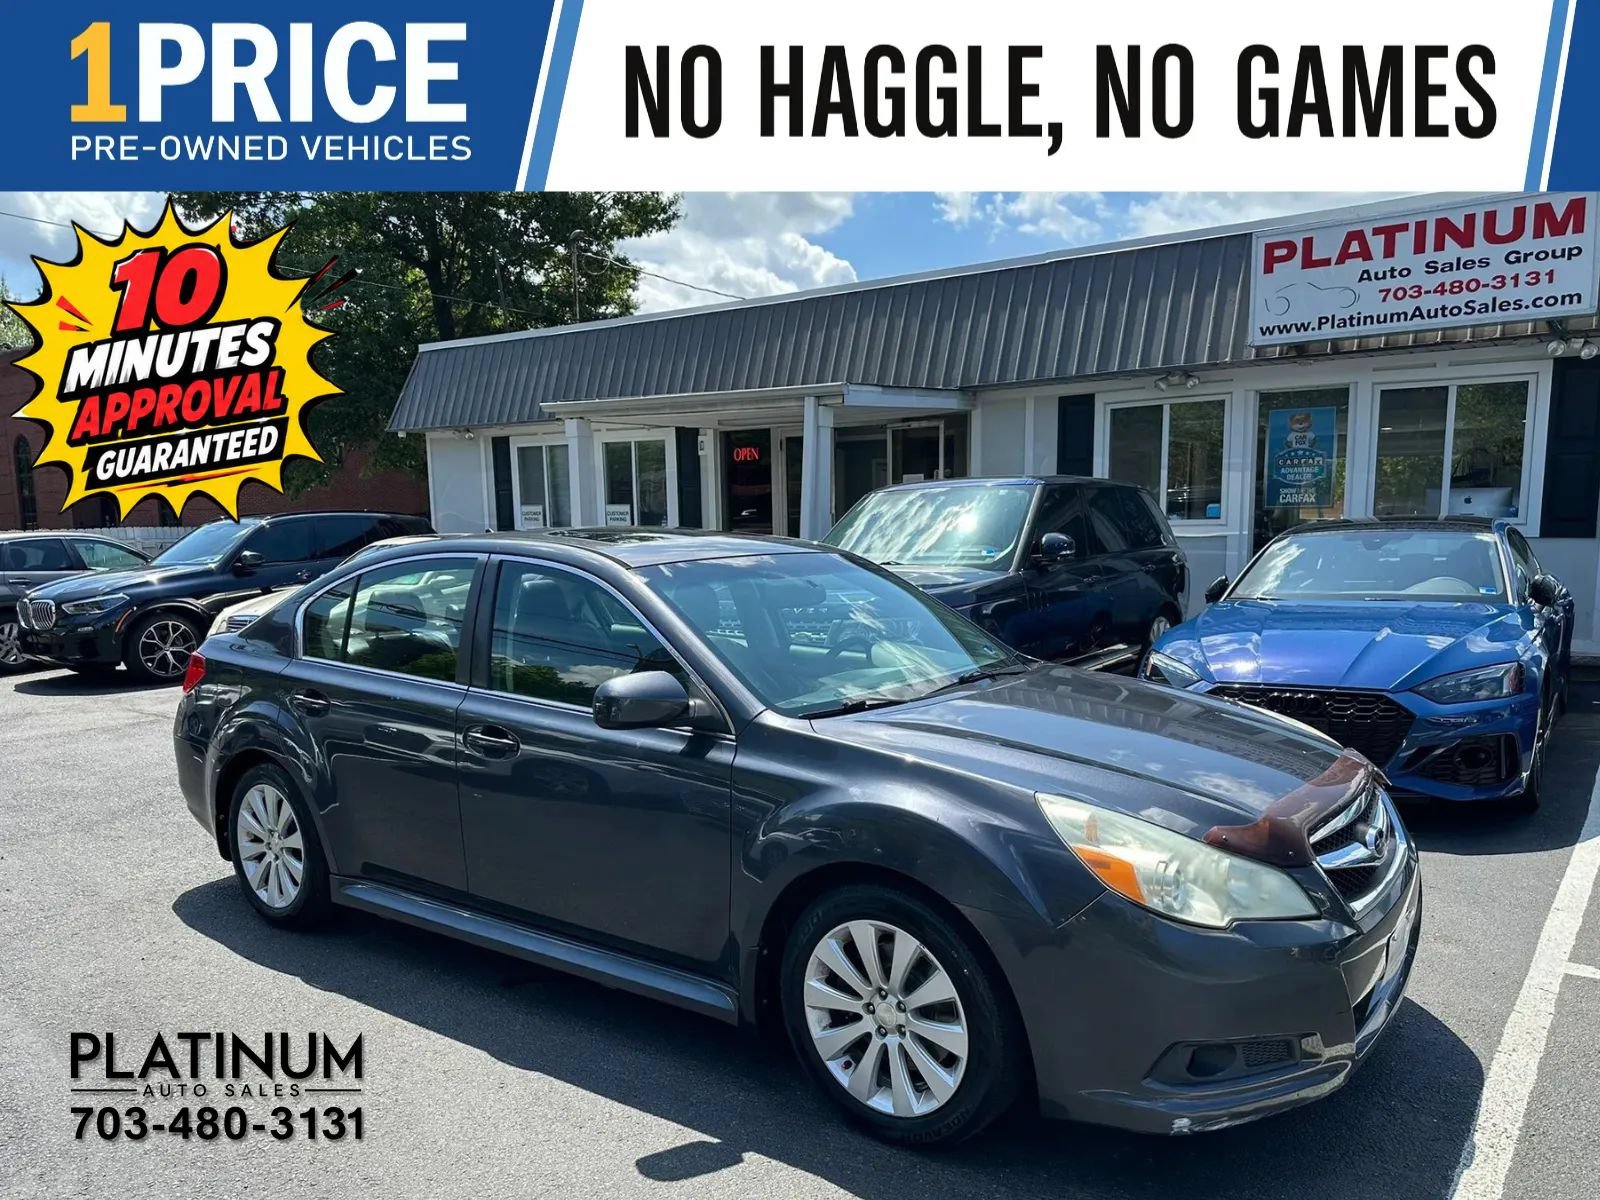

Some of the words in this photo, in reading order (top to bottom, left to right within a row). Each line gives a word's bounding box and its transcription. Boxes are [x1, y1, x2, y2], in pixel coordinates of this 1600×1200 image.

[1263, 196, 1587, 275] PLATINUM
[1357, 265, 1412, 283] Auto
[1424, 254, 1491, 275] Sales
[1504, 245, 1583, 264] Group
[1378, 268, 1555, 303] 703-480-3131
[1259, 291, 1583, 337] www.PlatinumAutoSales.com
[733, 447, 760, 461] OPEN
[1281, 466, 1319, 474] ADVANTAGE
[1279, 493, 1316, 503] CARFAX
